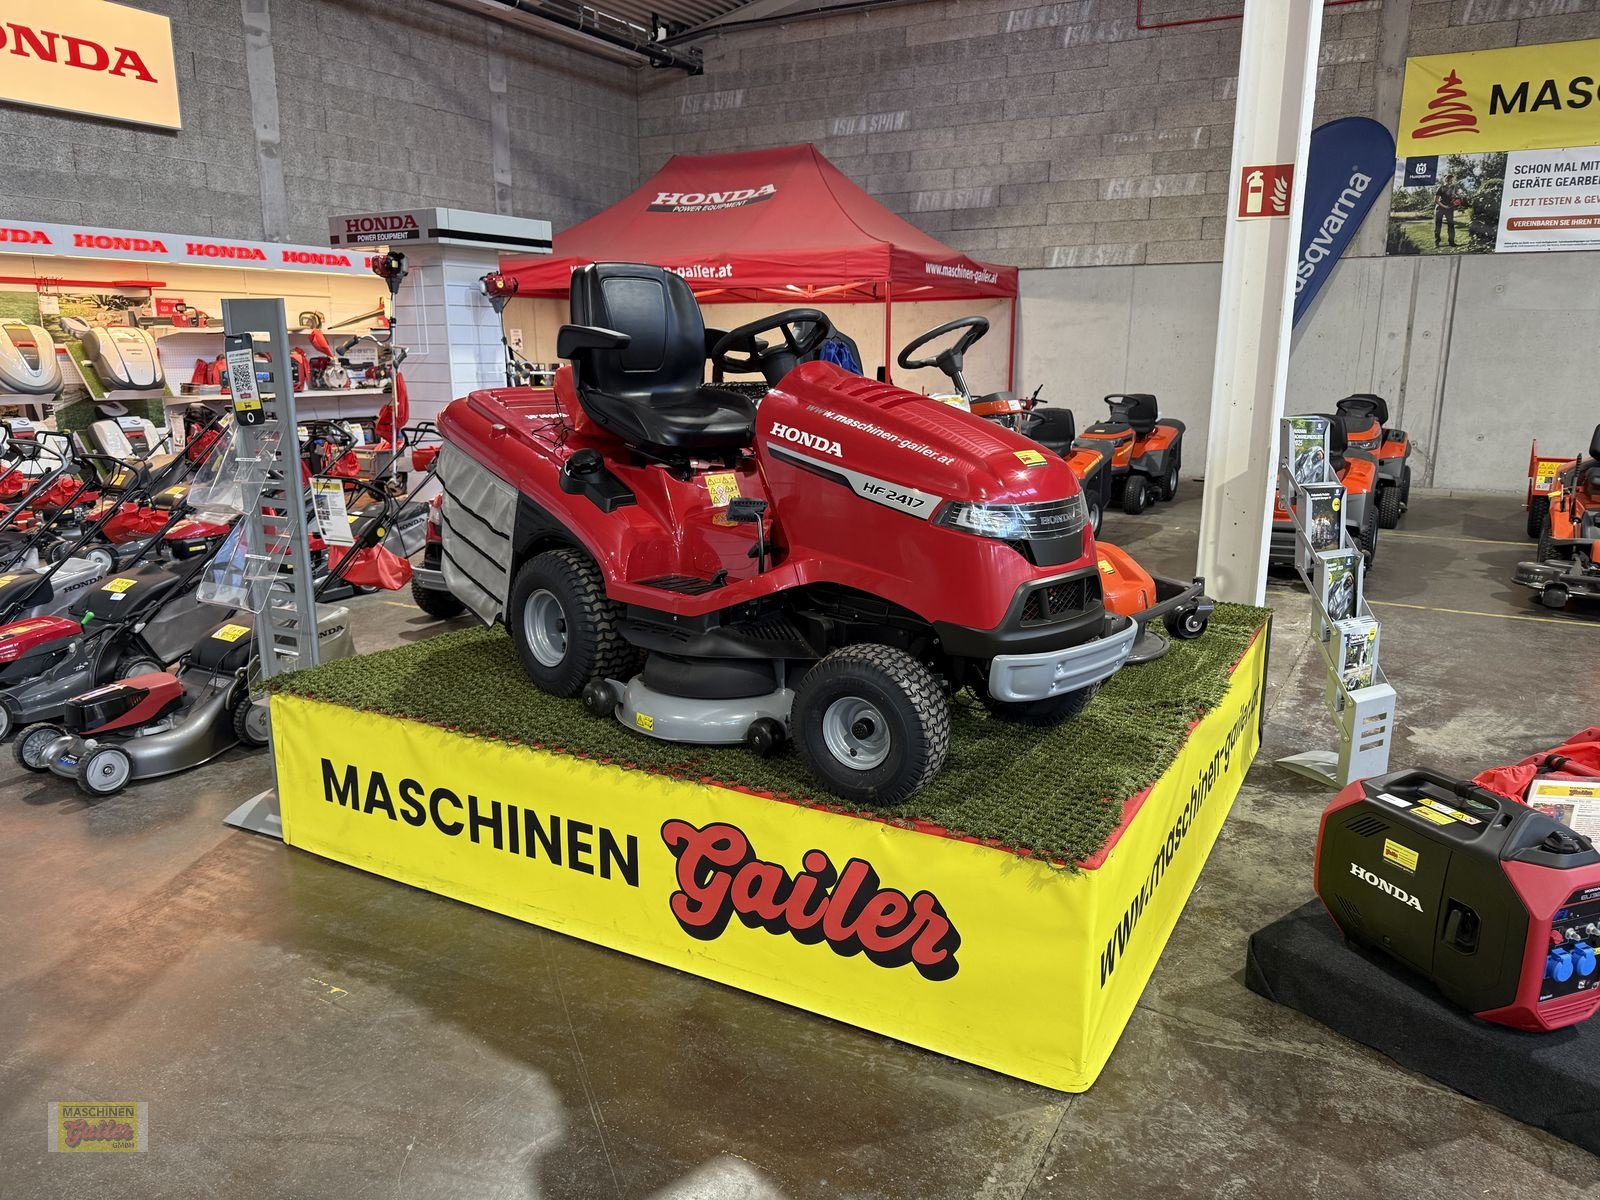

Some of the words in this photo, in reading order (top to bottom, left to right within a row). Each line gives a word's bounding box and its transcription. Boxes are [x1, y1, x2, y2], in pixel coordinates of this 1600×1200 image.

[0, 22, 158, 83] NDA
[1489, 76, 1600, 115] MAS
[1514, 164, 1551, 174] SCHON
[1554, 162, 1577, 172] MAL
[1580, 160, 1600, 171] MIT
[1512, 176, 1553, 189] GERÄTE
[651, 183, 776, 205] HONDA
[1509, 198, 1536, 207] JETZT
[1538, 196, 1572, 206] TESTEN
[1574, 196, 1581, 204] &
[672, 204, 701, 212] POWER
[702, 200, 747, 212] EQUIPMENT
[345, 215, 418, 232] HONDA
[1513, 219, 1558, 228] VEREINBAREN
[1571, 218, 1592, 226] IHREN
[73, 234, 168, 253] HONDA
[357, 234, 376, 242] POWER
[377, 232, 408, 241] EQUIPMENT
[1293, 172, 1372, 299] usqvarna
[186, 243, 266, 260] HONDA
[282, 251, 351, 267] HONDA
[925, 263, 998, 284] www.maschinen-gailer.at
[770, 421, 843, 458] HONDA
[806, 404, 955, 466] www.maschinen-gailer.at
[863, 482, 887, 495] HF
[887, 489, 925, 507] 2417
[63, 575, 103, 594] HONDA
[318, 625, 345, 639] NDA
[1100, 677, 1260, 990] www.maschinen-gailer.at
[320, 757, 640, 887] MASCHINEN
[660, 817, 962, 981] Gailer
[1349, 862, 1424, 912] HONDA
